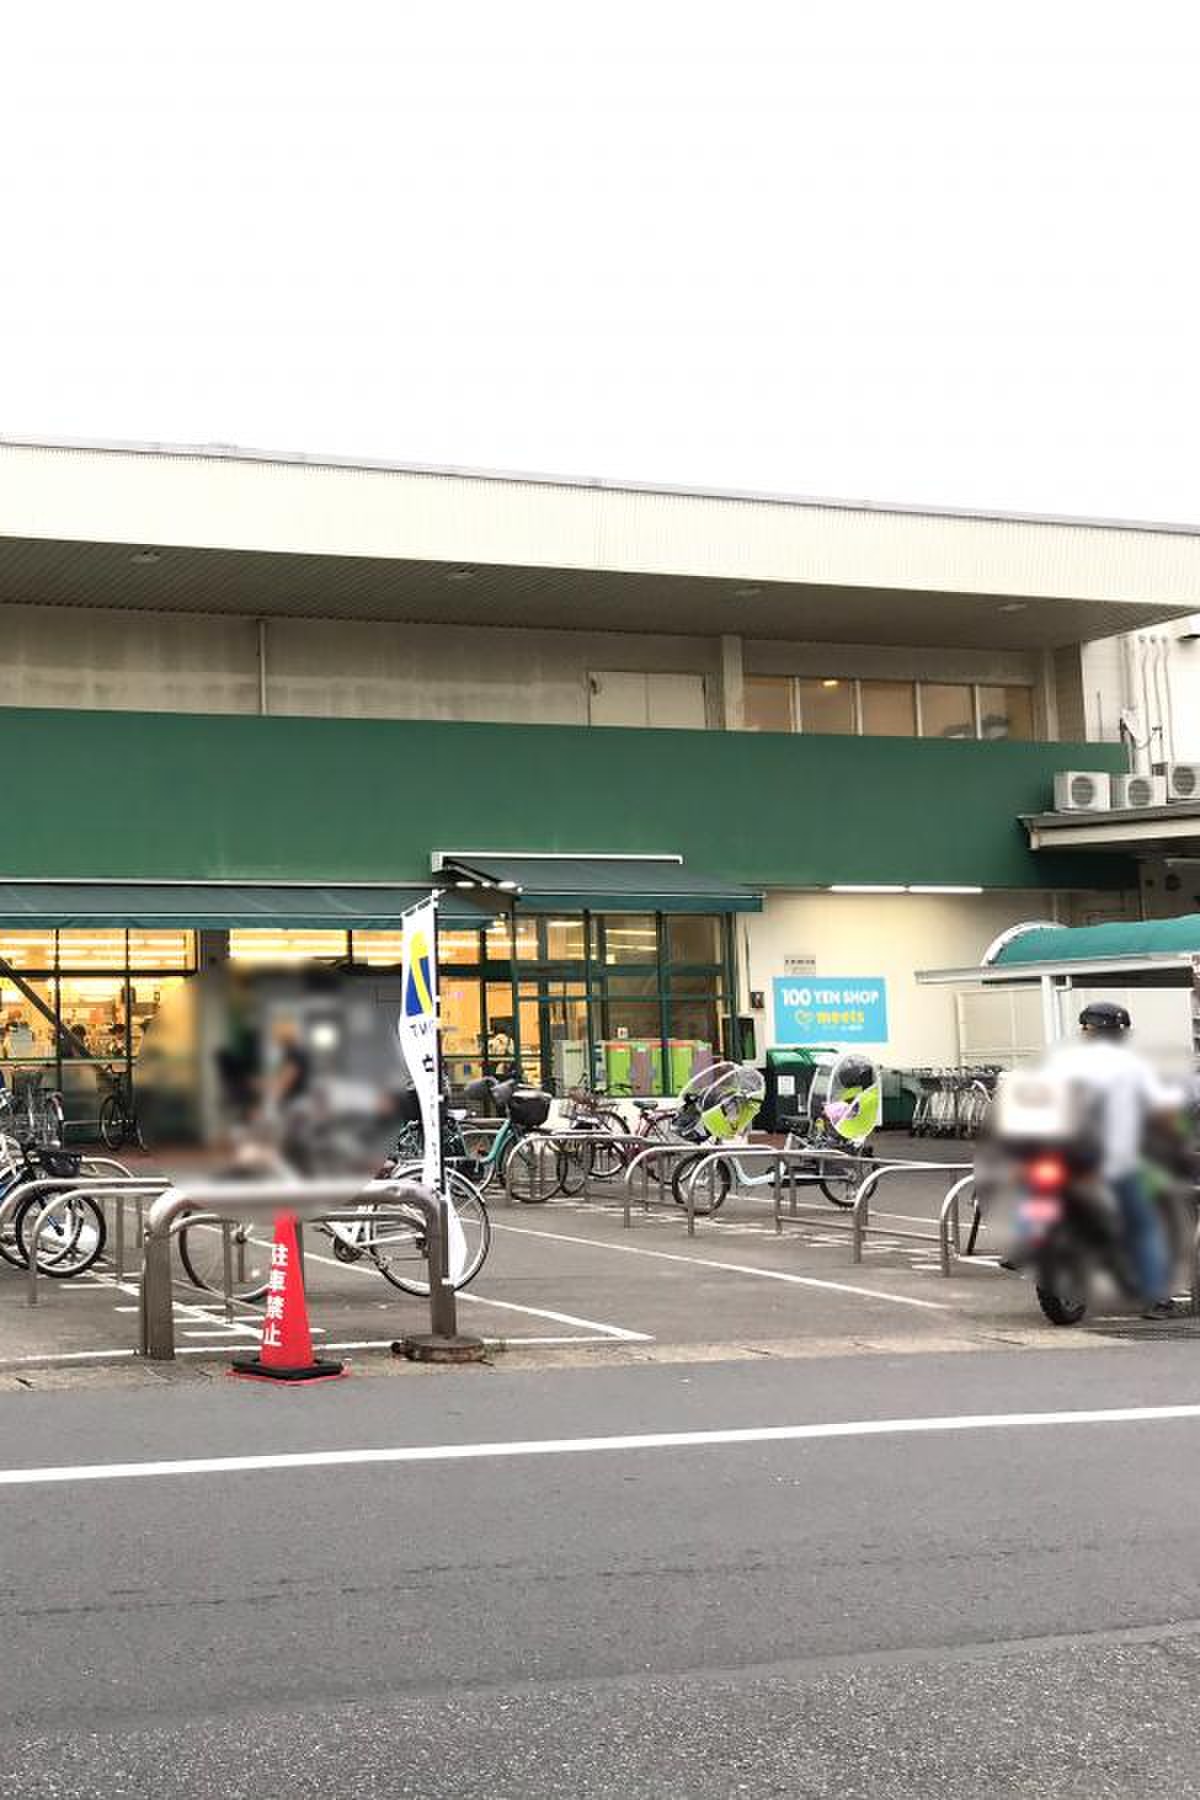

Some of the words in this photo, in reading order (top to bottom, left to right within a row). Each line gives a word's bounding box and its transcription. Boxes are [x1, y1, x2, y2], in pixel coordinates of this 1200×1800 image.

[781, 988, 812, 1006] 100
[814, 991, 841, 1005] YEN
[843, 990, 879, 1005] SHOP
